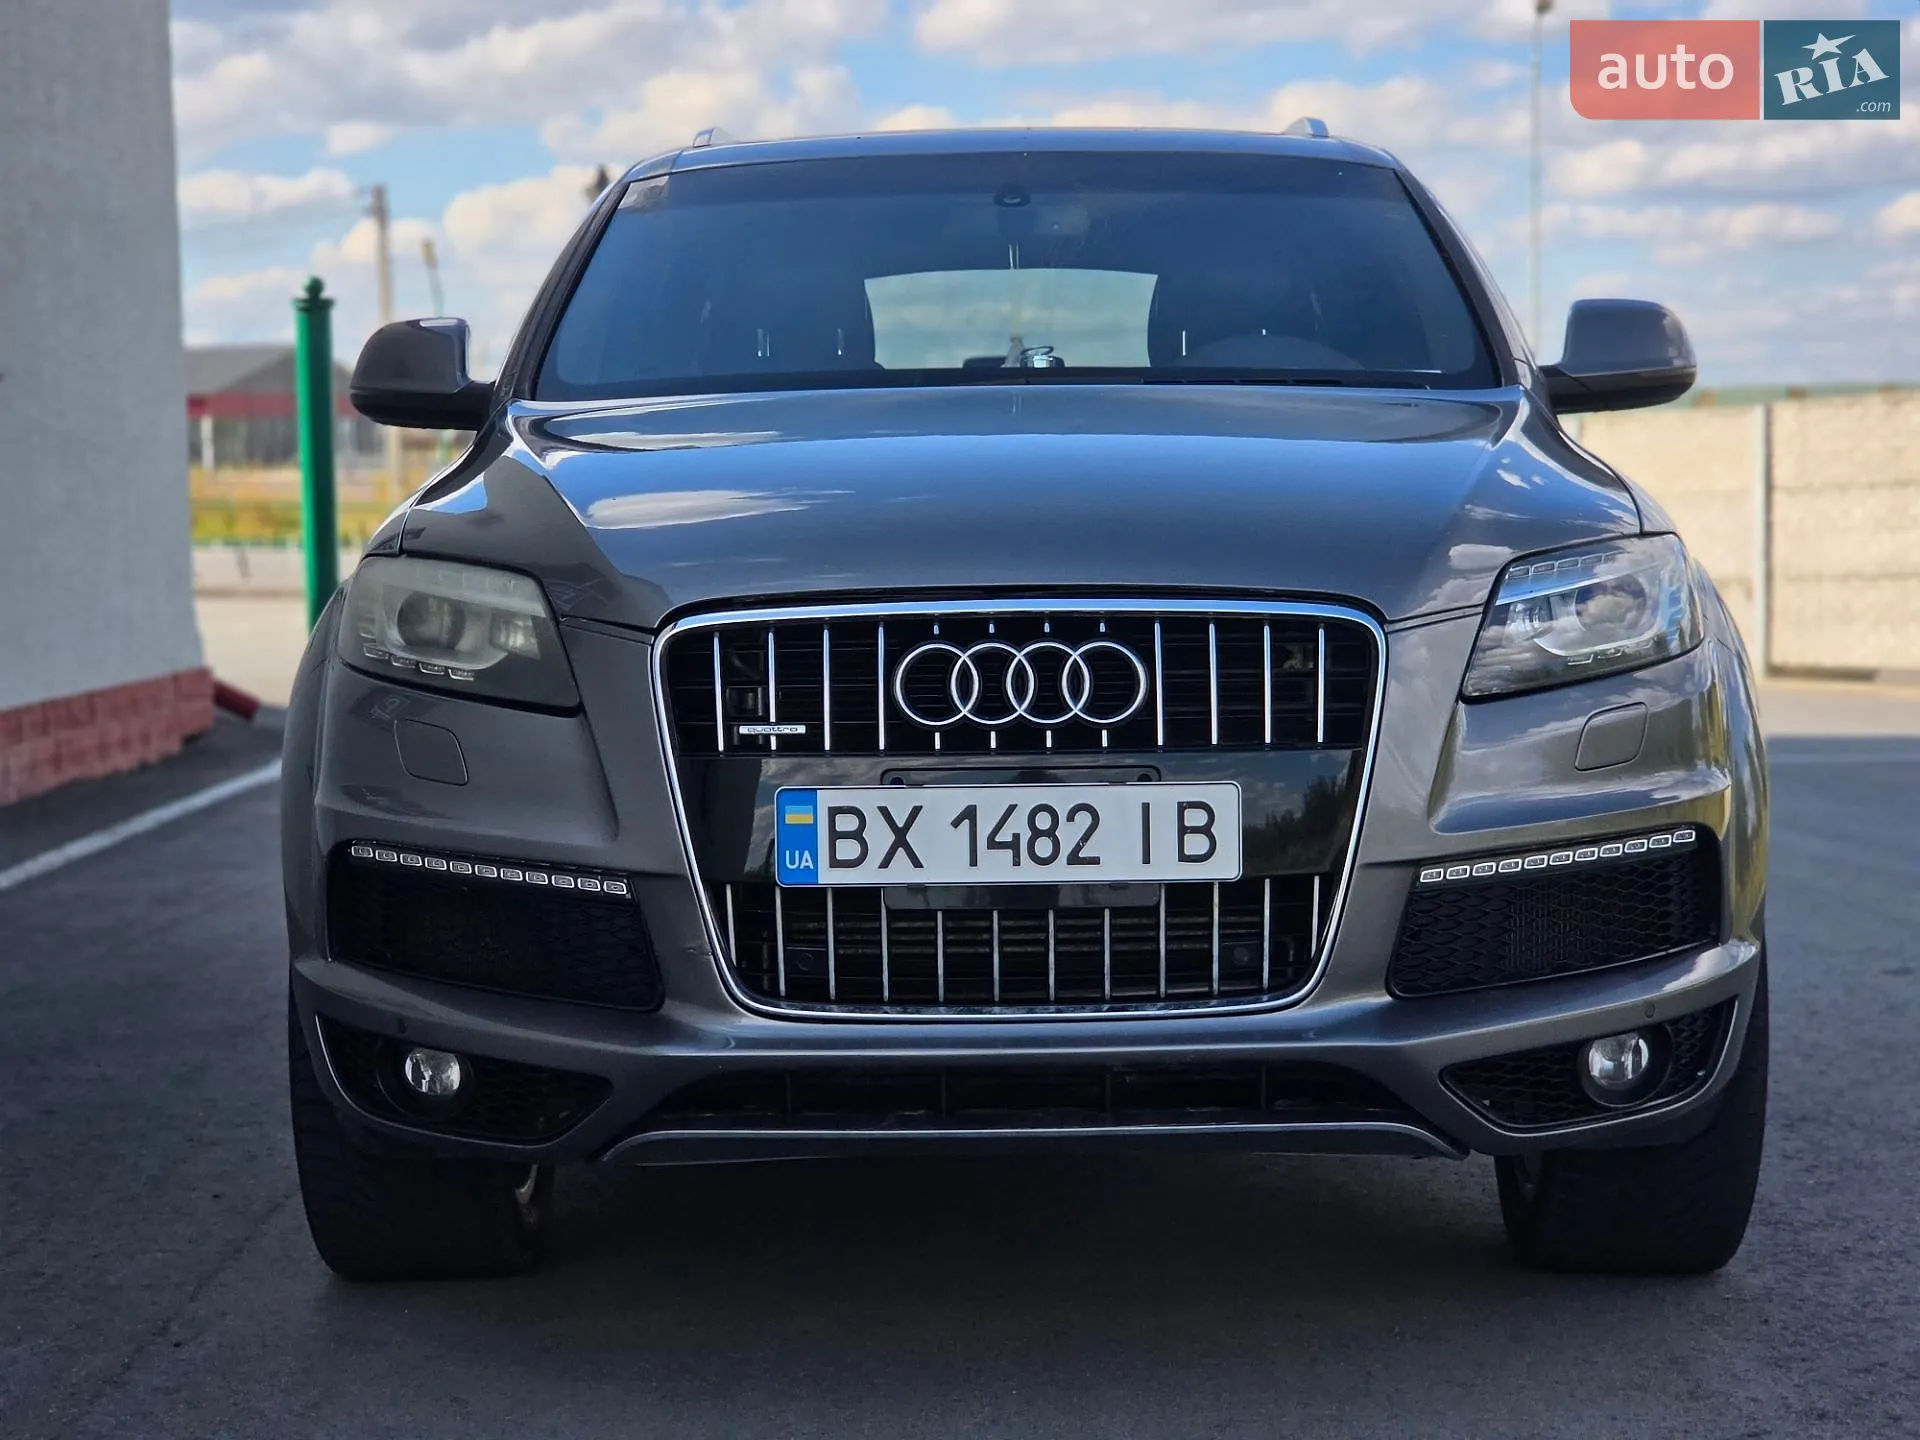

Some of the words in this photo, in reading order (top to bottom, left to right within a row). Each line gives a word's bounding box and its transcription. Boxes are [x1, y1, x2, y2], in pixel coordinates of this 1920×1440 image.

[747, 726, 798, 734] quattro
[827, 805, 925, 869] BX
[950, 802, 1101, 867] 1482
[1141, 800, 1217, 865] IB
[785, 850, 814, 870] UA
